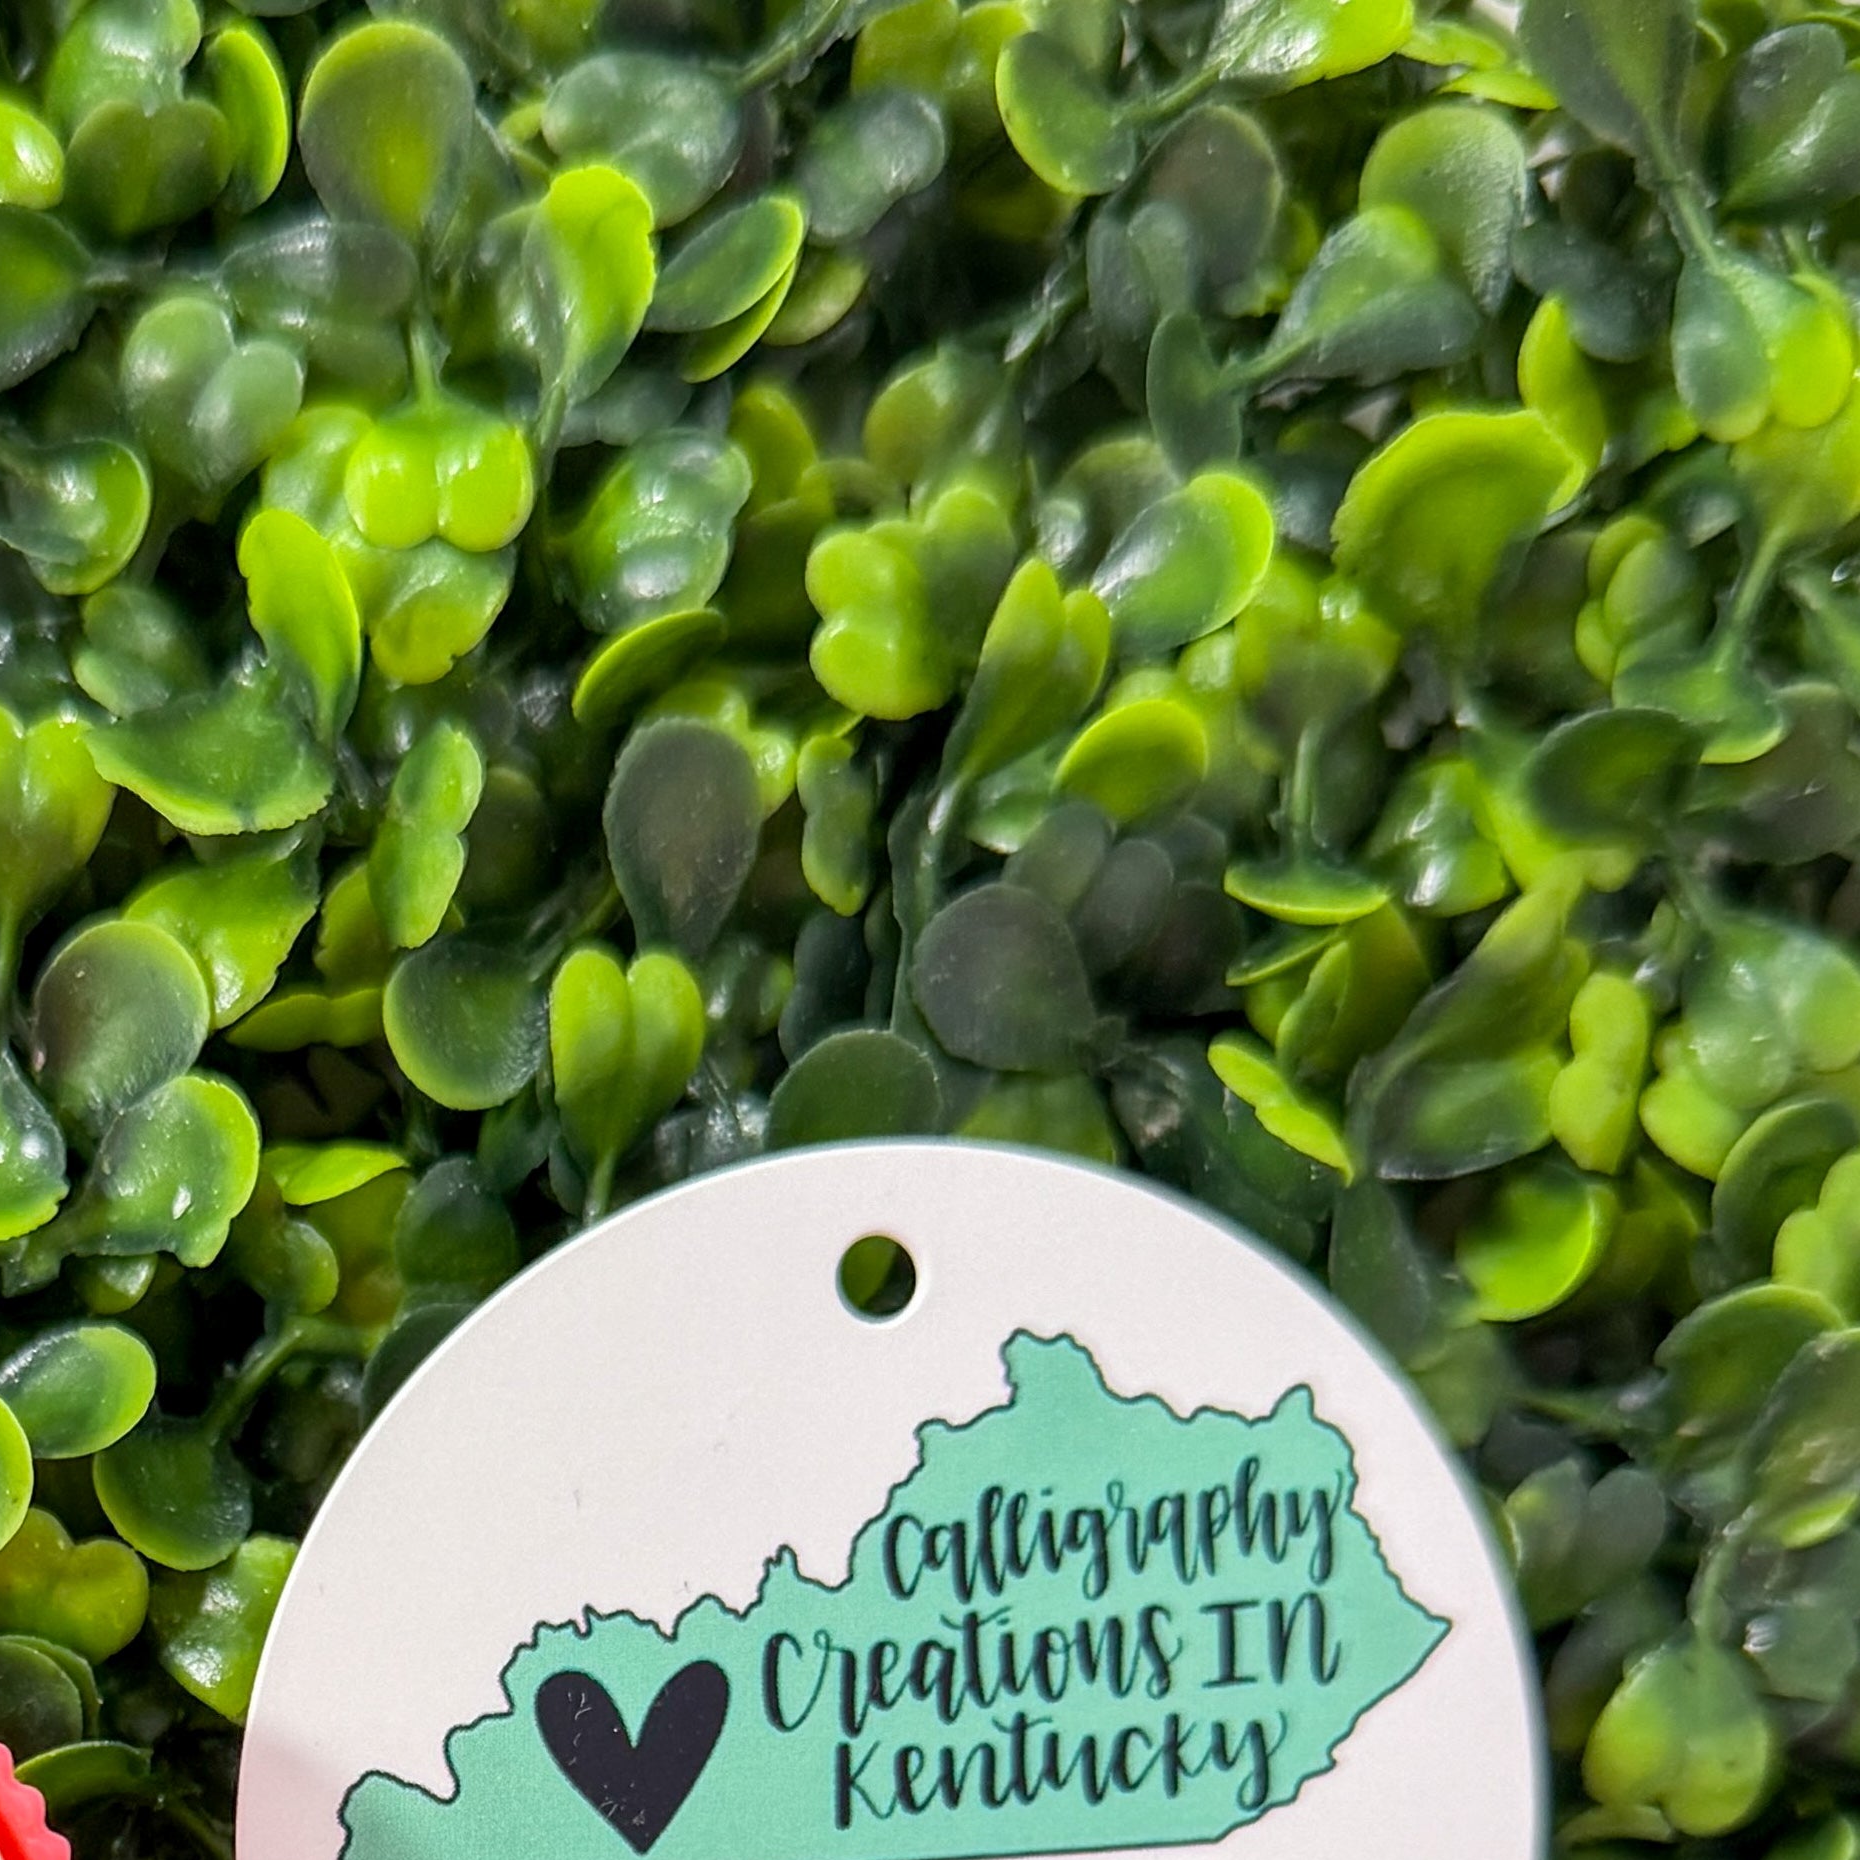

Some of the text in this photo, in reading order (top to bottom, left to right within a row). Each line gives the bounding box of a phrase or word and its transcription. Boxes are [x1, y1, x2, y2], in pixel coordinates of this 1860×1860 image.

[883, 1455, 1344, 1602] Calligraphy
[762, 1604, 1183, 1736] Creations
[832, 1710, 1287, 1830] Kentucky
